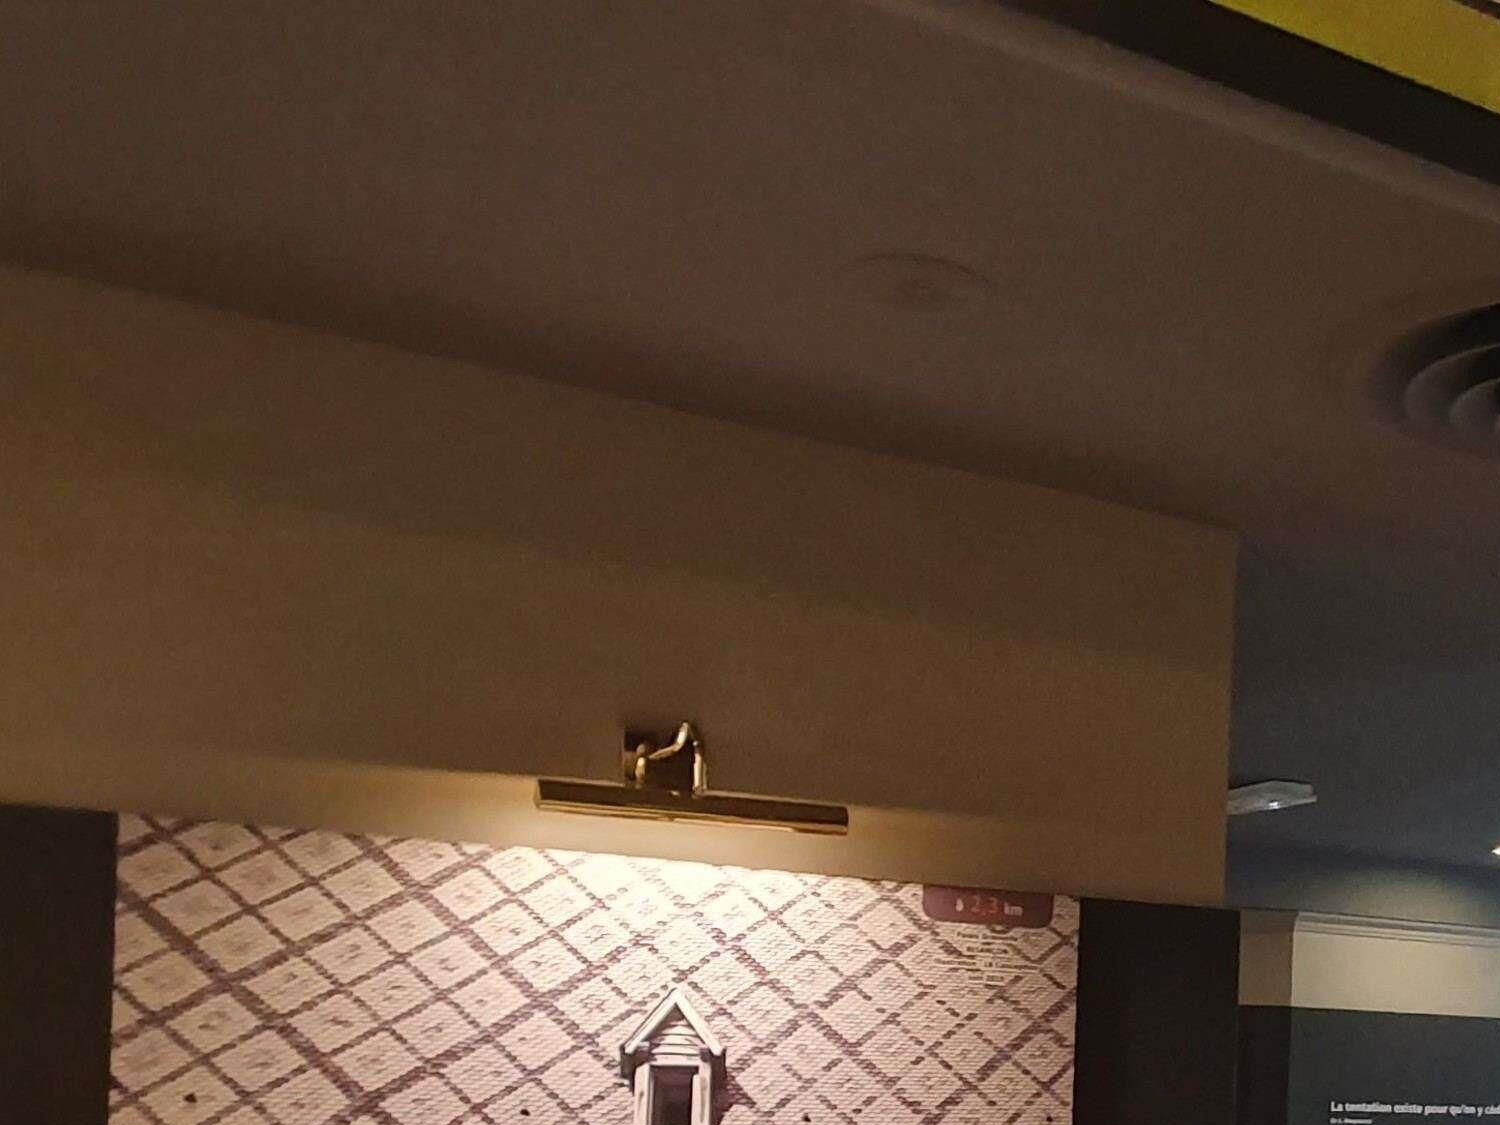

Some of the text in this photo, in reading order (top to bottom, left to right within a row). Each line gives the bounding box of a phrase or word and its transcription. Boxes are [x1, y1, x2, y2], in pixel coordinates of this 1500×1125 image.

[1004, 901, 1024, 916] km
[1330, 1100, 1344, 1112] La
[1345, 1101, 1392, 1113] tentation
[1393, 1102, 1423, 1114] existe
[1424, 1104, 1448, 1117] pour
